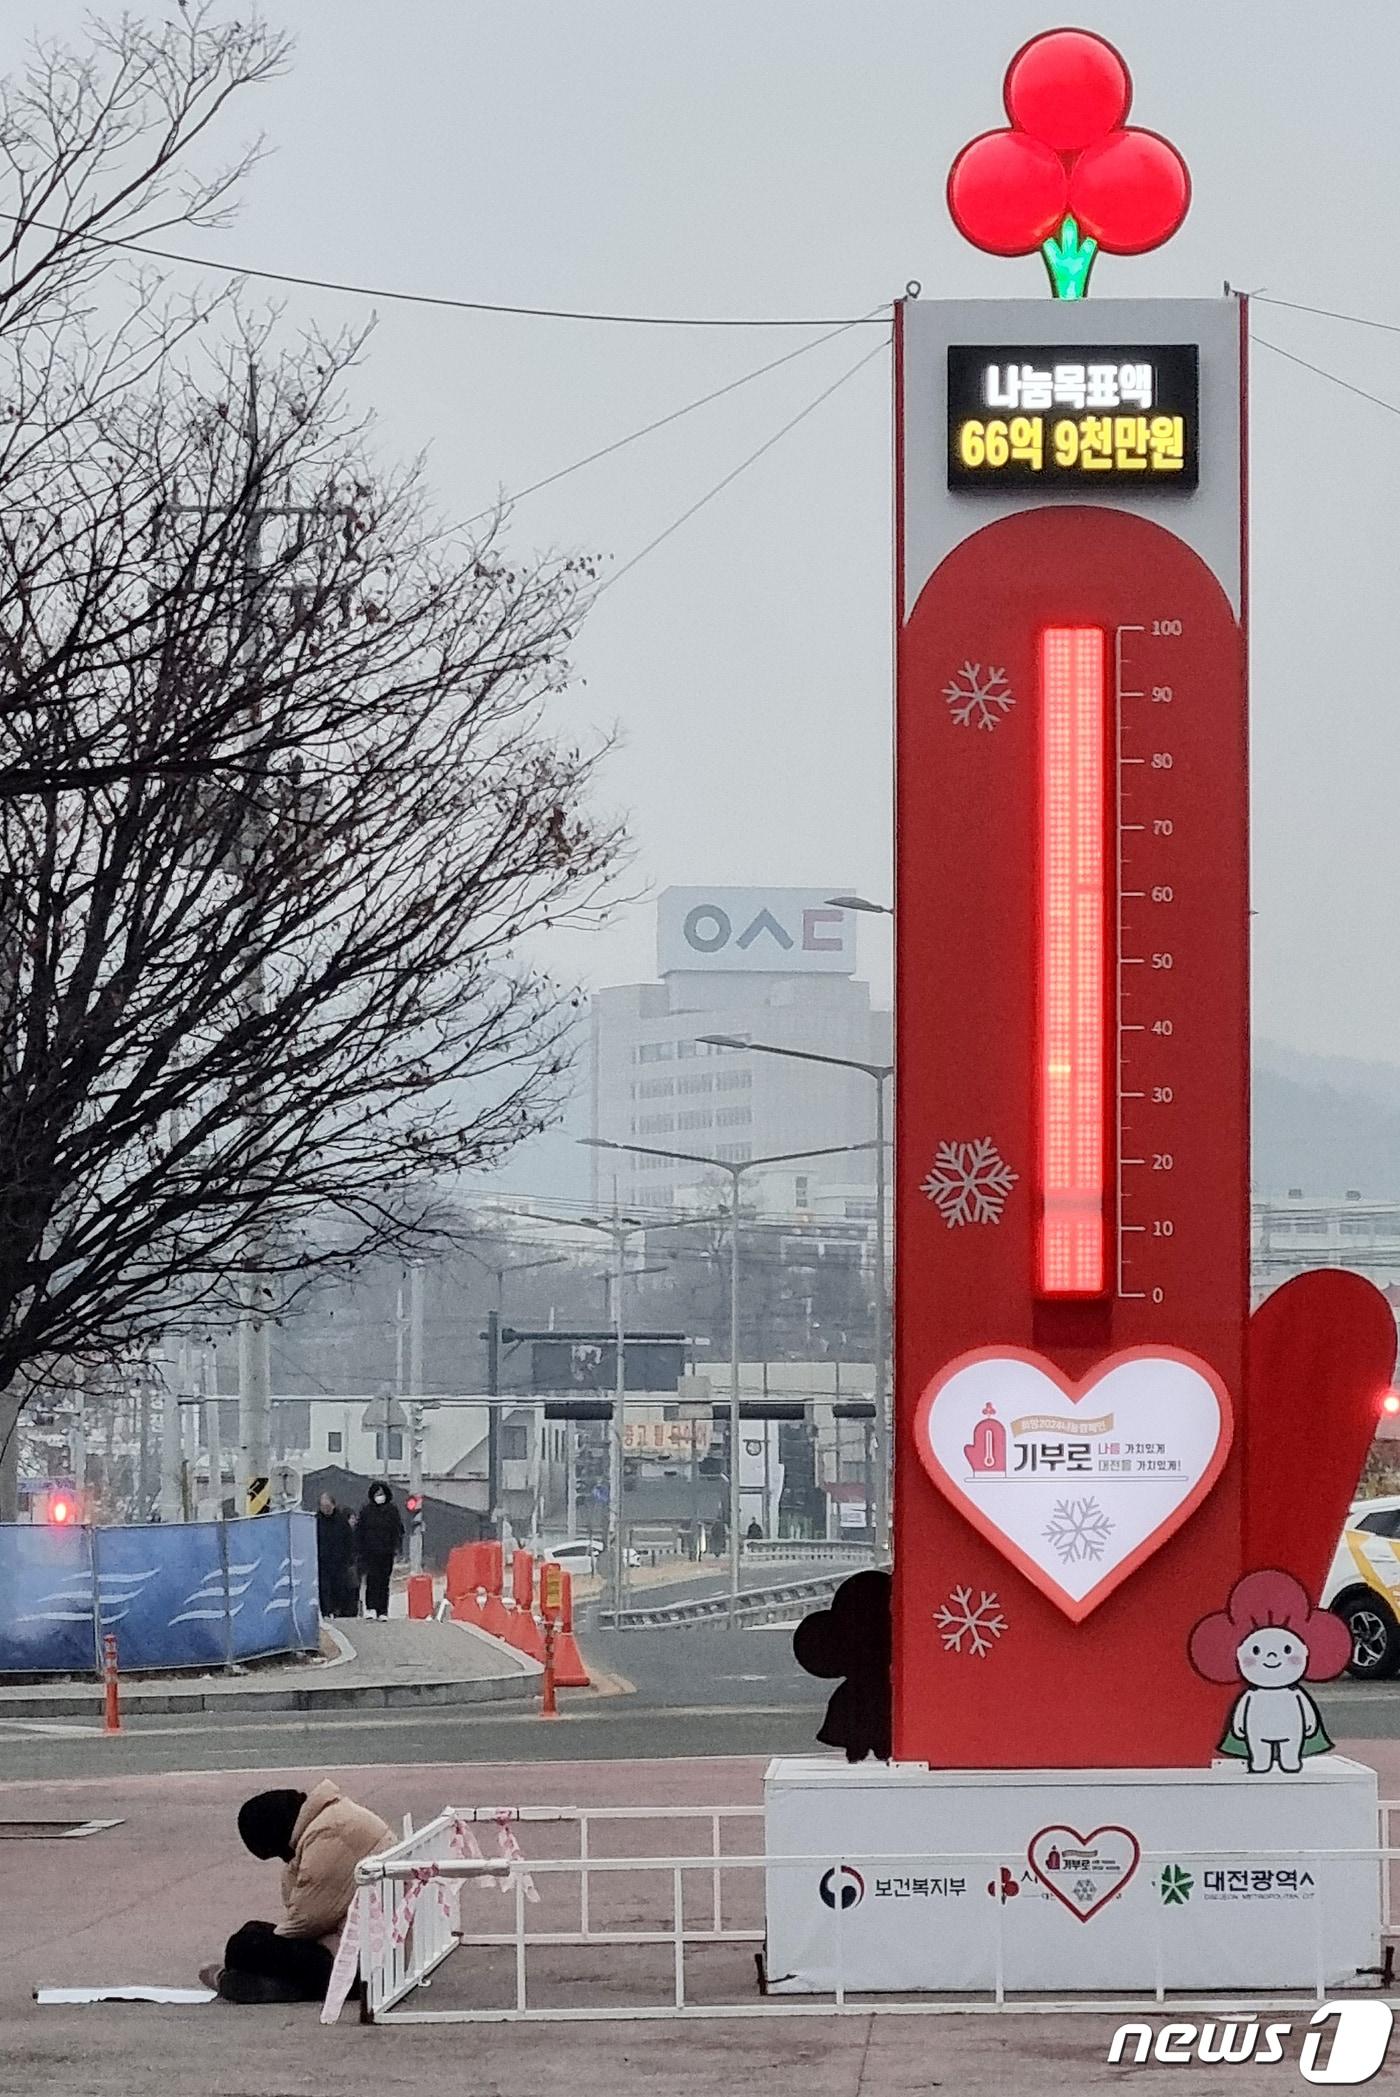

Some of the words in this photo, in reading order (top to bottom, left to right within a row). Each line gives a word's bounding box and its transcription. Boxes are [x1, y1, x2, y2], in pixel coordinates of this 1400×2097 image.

[986, 363, 1152, 409] 나눔목표액
[961, 416, 1043, 470] 66억
[1054, 416, 1184, 470] 9천만원
[1151, 619, 1183, 636] 100
[1151, 686, 1173, 703] 90
[1151, 753, 1173, 769] 80
[1153, 820, 1173, 835] 70
[1151, 886, 1173, 902] 60
[1152, 953, 1173, 969] 50
[1151, 1020, 1173, 1036] 40
[1152, 1086, 1173, 1103] 30
[1152, 1154, 1173, 1170] 20
[1153, 1221, 1173, 1236] 10
[1152, 1288, 1163, 1304] 0
[1014, 1443, 1093, 1471] 기부로
[1098, 1443, 1120, 1455] 나를
[1125, 1443, 1166, 1455] 가치있게
[1098, 1460, 1132, 1471] 대전을
[874, 1878, 967, 1898] 보건복지부
